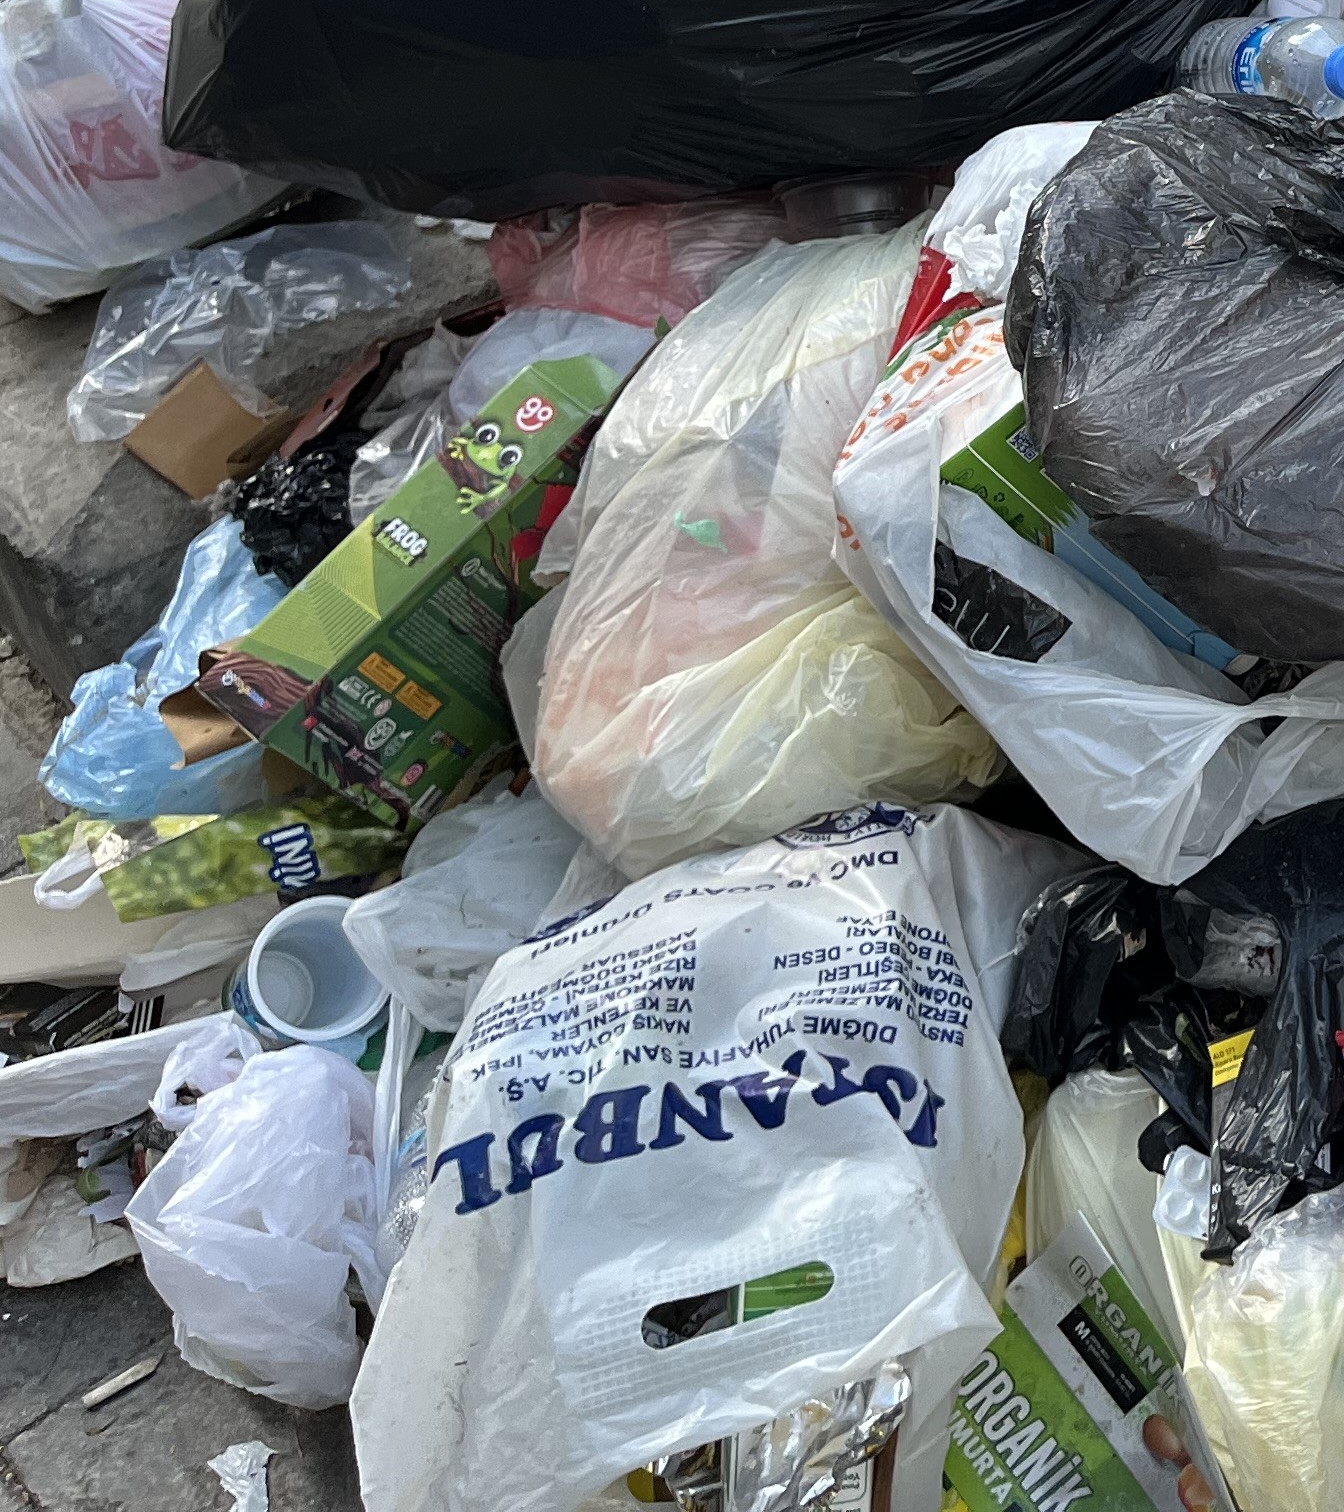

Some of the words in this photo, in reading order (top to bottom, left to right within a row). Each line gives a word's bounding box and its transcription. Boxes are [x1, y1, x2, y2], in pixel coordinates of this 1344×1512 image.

[380, 517, 428, 557] FROG
[830, 850, 899, 882] DMC
[772, 945, 841, 971] DESEN
[550, 996, 660, 1042] KETENLER
[666, 997, 693, 1013] VE
[631, 1014, 691, 1035] NAKIŞ
[802, 1015, 898, 1046] DÜĞME
[614, 1043, 673, 1067] SAN.
[678, 1016, 796, 1070] TUHAFİYE
[497, 1072, 552, 1103] A.Ş.
